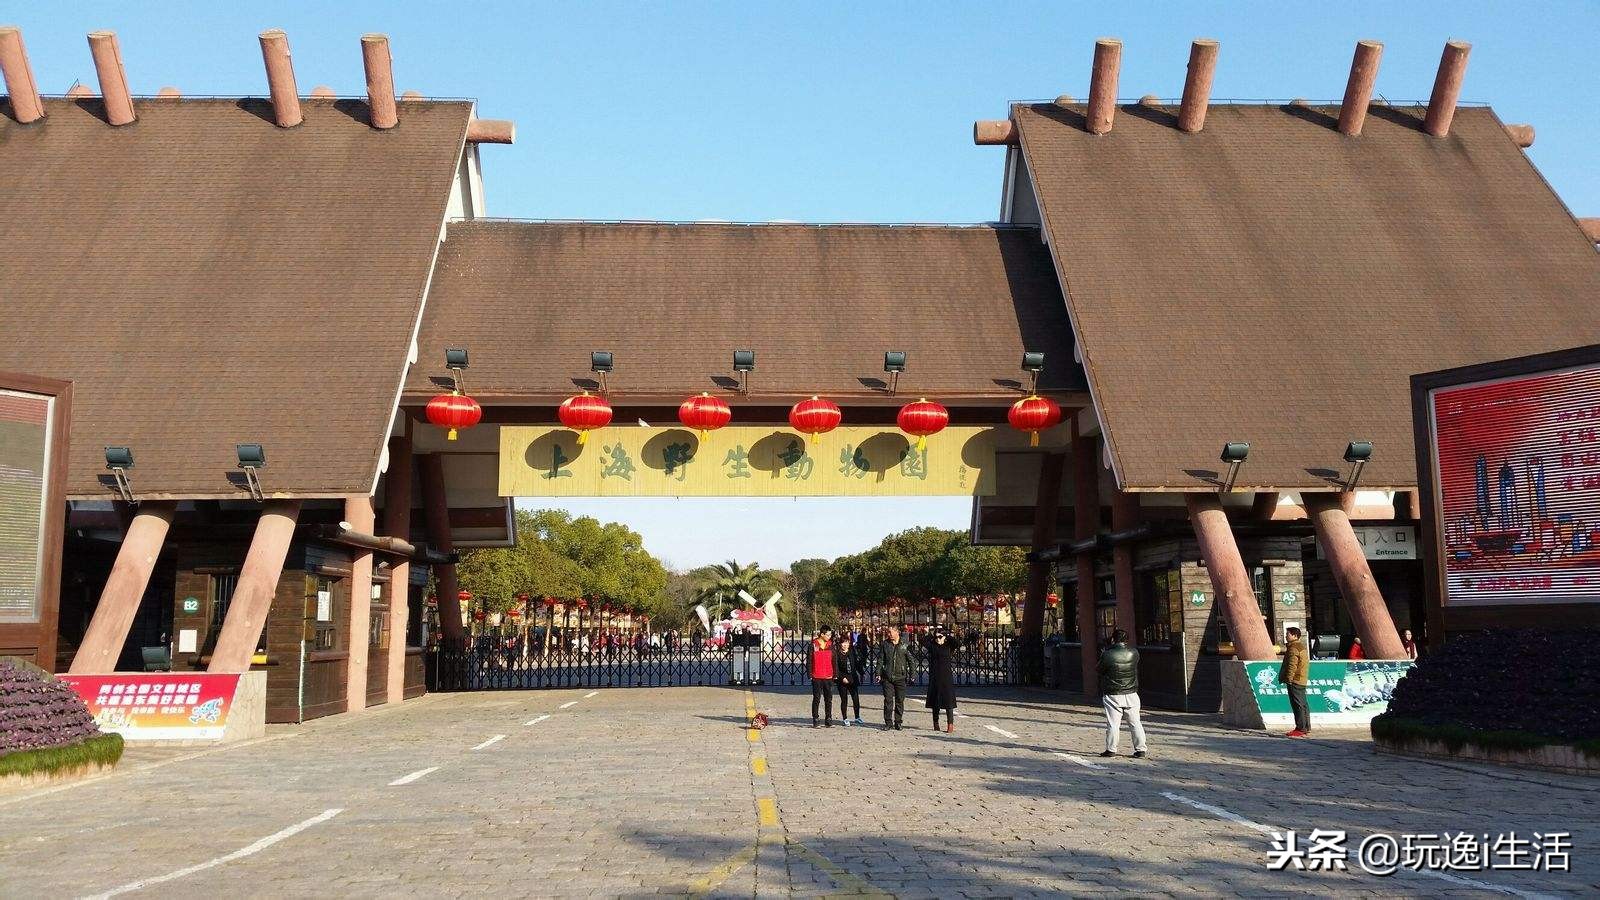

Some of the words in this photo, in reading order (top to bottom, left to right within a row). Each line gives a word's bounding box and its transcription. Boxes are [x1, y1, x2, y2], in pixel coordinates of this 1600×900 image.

[1191, 593, 1205, 603] A4
[1282, 592, 1296, 602] A5
[183, 600, 198, 611] B2
